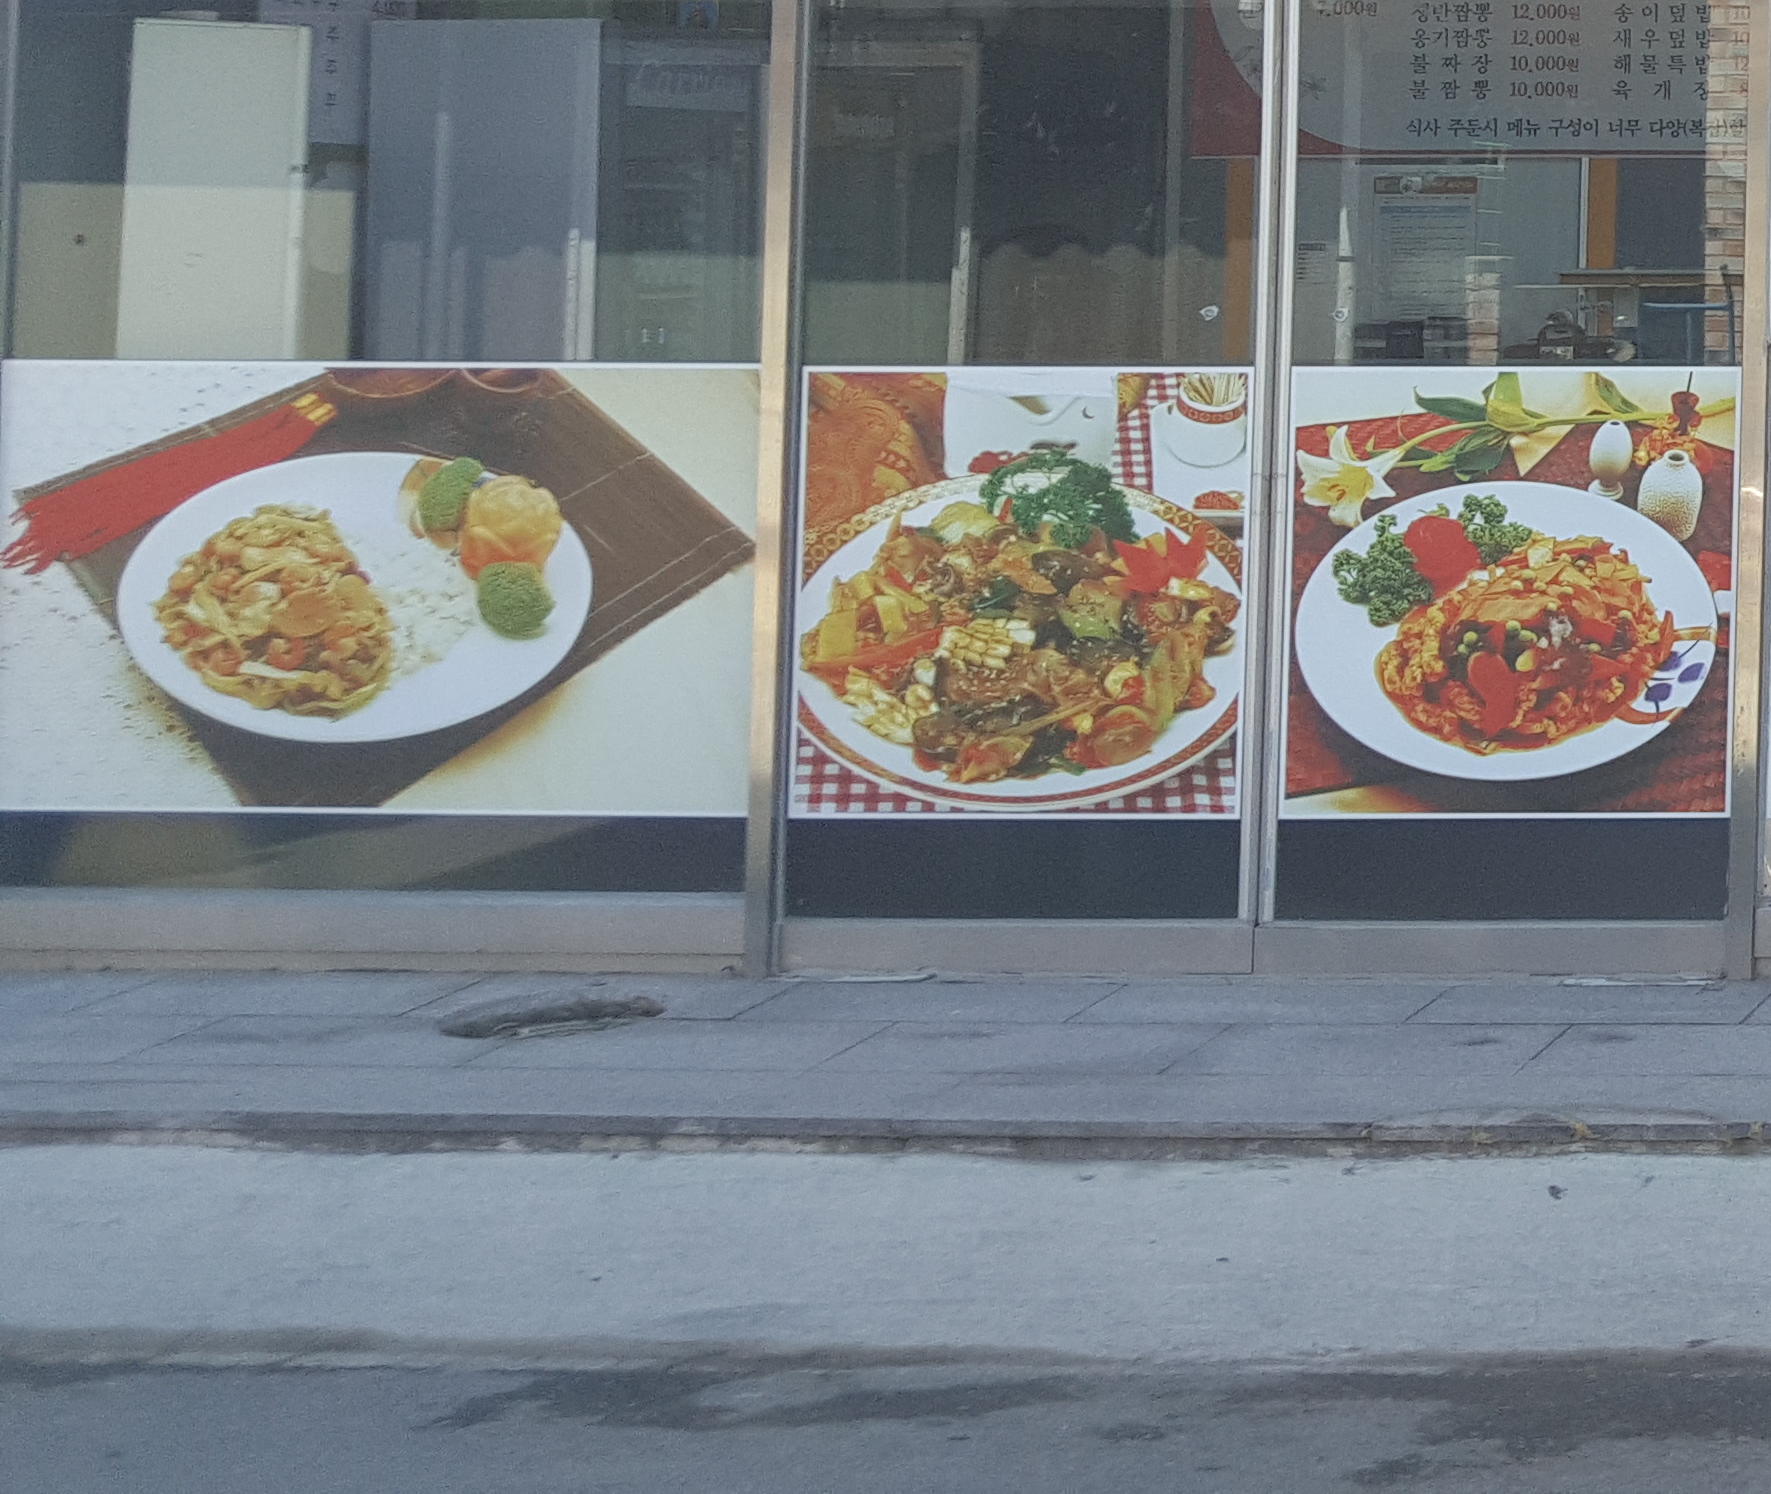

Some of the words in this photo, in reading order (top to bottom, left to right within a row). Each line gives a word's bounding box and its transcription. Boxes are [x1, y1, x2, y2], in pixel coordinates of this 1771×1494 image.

[1405, 118, 1441, 138] 식사
[1506, 118, 1540, 138] 메뉴
[1549, 118, 1598, 138] 구성이
[1609, 118, 1642, 138] 너무
